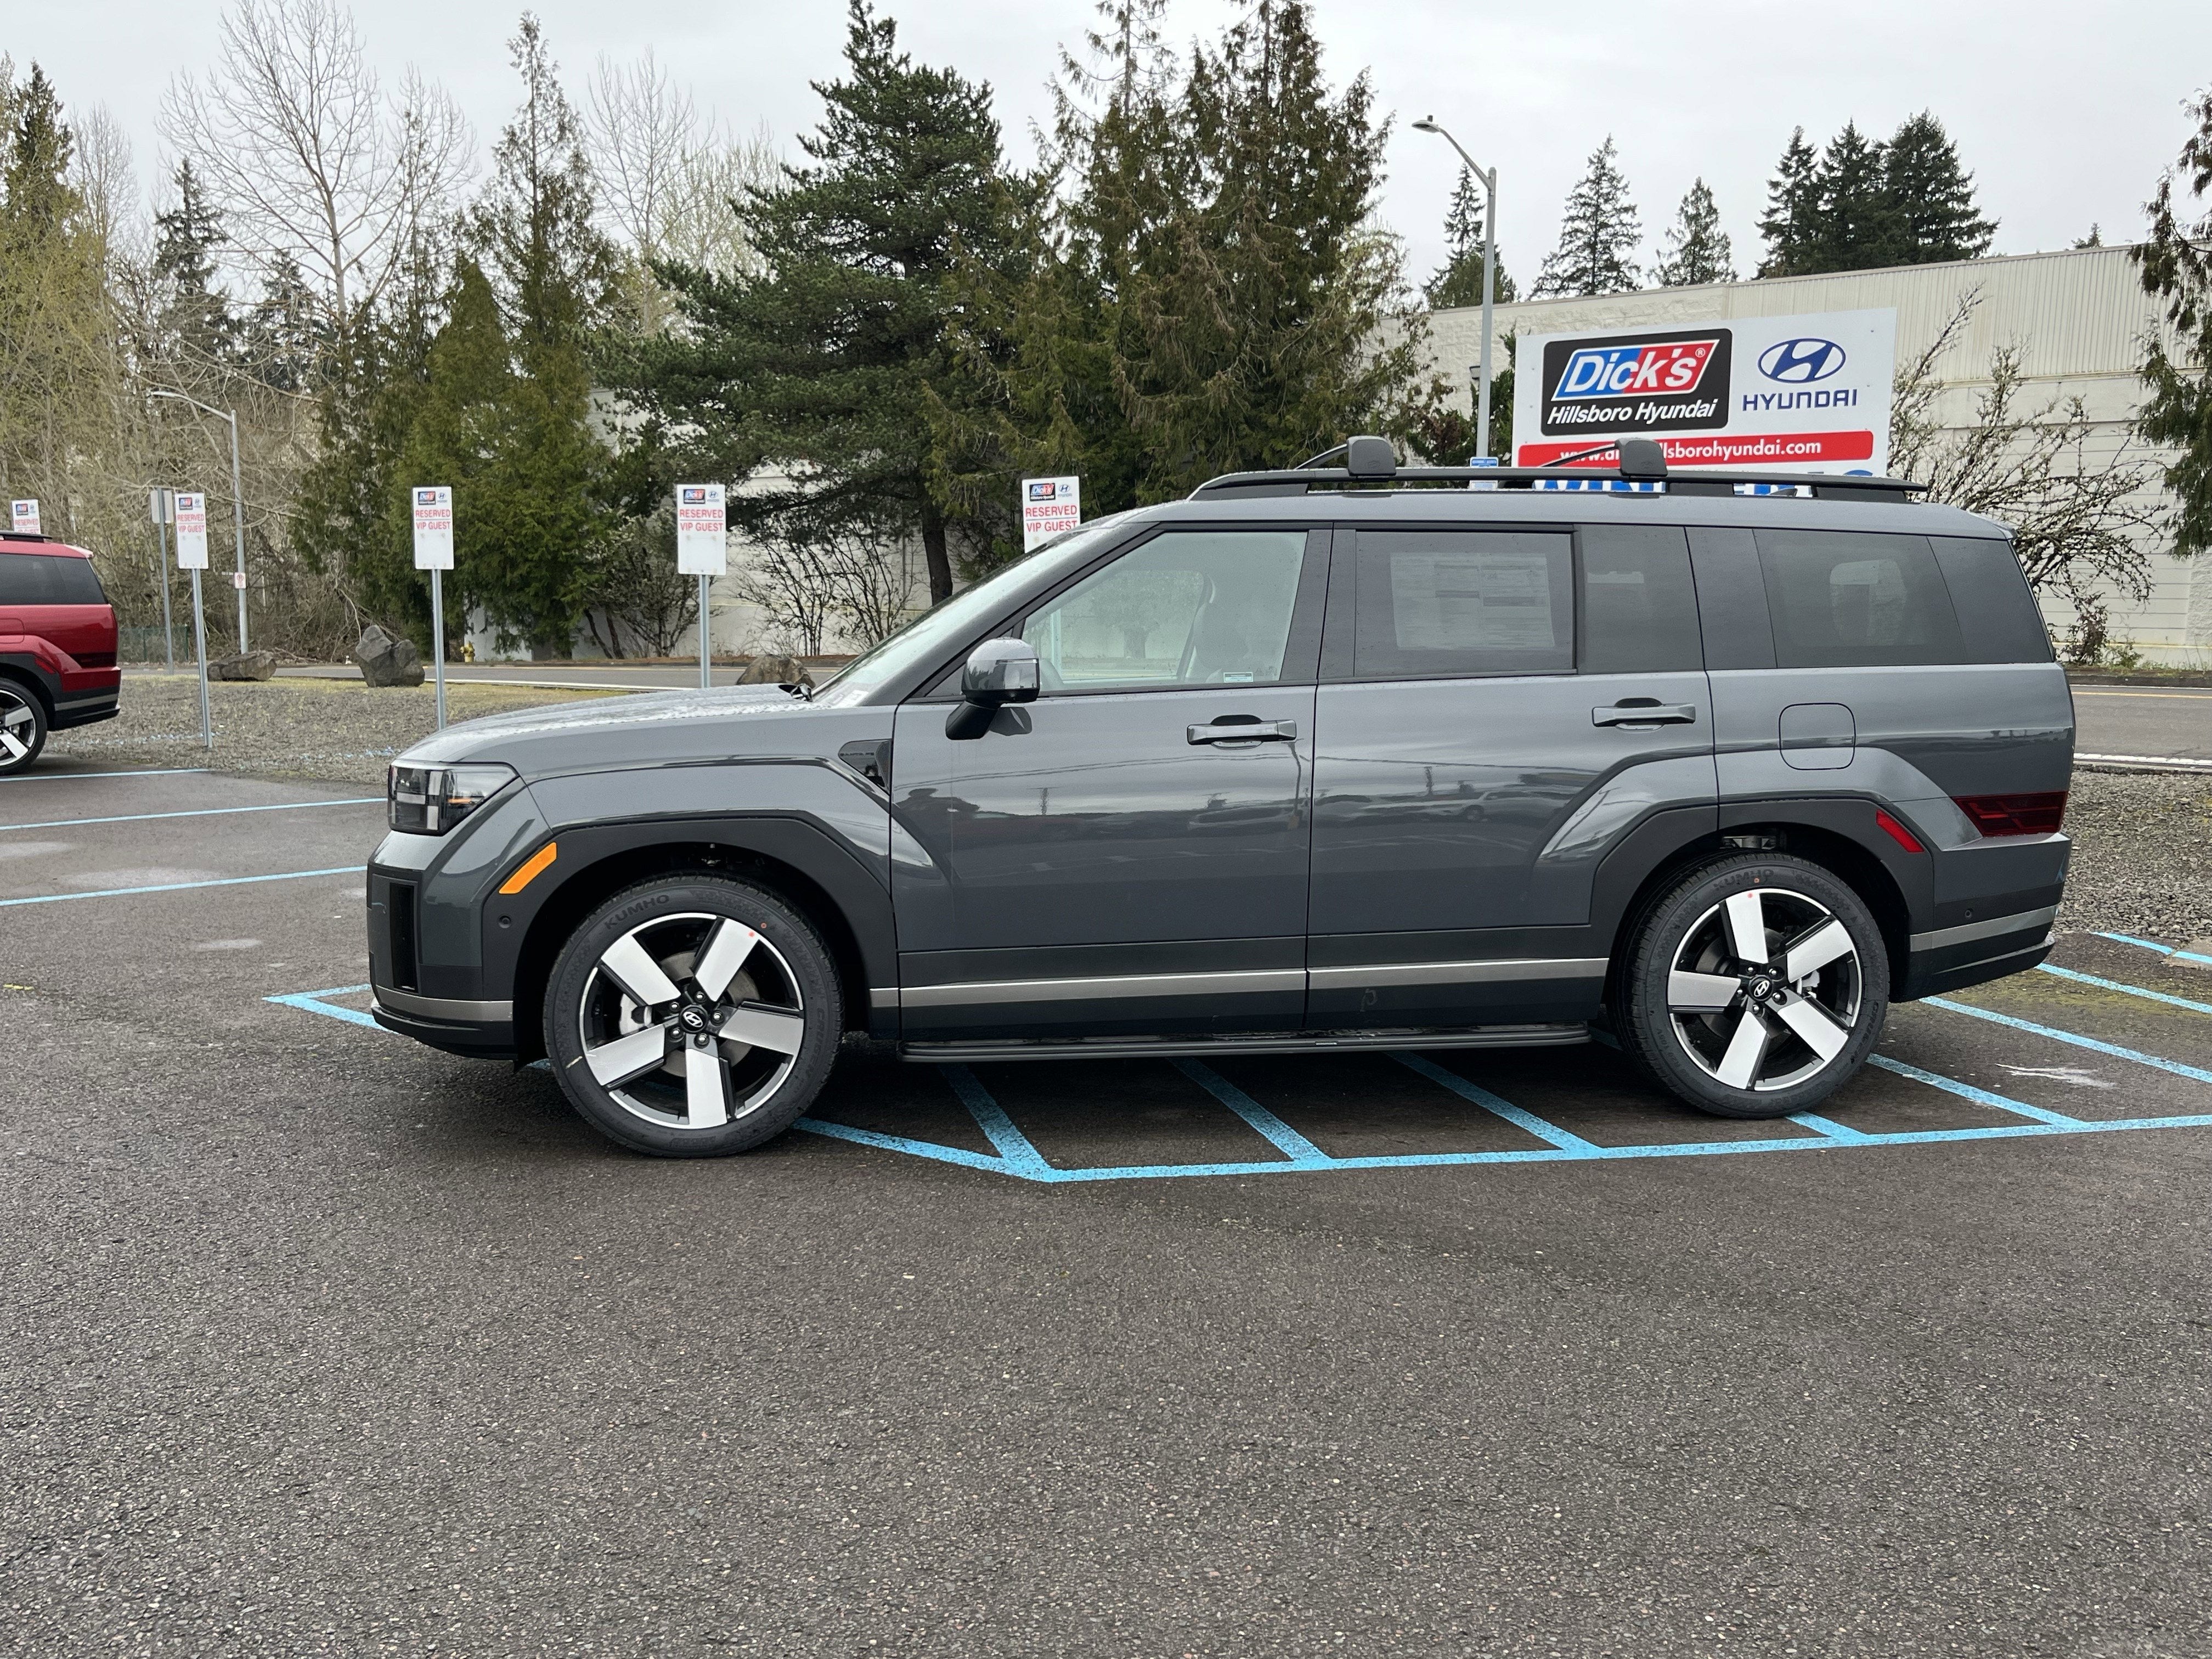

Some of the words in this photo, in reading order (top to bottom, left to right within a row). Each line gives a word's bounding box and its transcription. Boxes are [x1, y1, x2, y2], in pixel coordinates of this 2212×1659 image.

[1742, 389, 1857, 411] HYUNDAI
[1547, 405, 1632, 424] Hillsboro
[1634, 398, 1718, 424] Hyundai
[415, 509, 450, 517] RESERVED
[680, 509, 723, 518] RESERVED
[1025, 505, 1077, 517] RESERVED
[177, 514, 204, 522] RESERVED
[416, 522, 426, 530] VIP
[428, 521, 450, 530] GUEST
[680, 522, 693, 531] VIP
[696, 522, 723, 532] GUEST
[1026, 522, 1041, 532] VIP
[1045, 520, 1077, 532] GUEST
[605, 894, 670, 930] KUMHO
